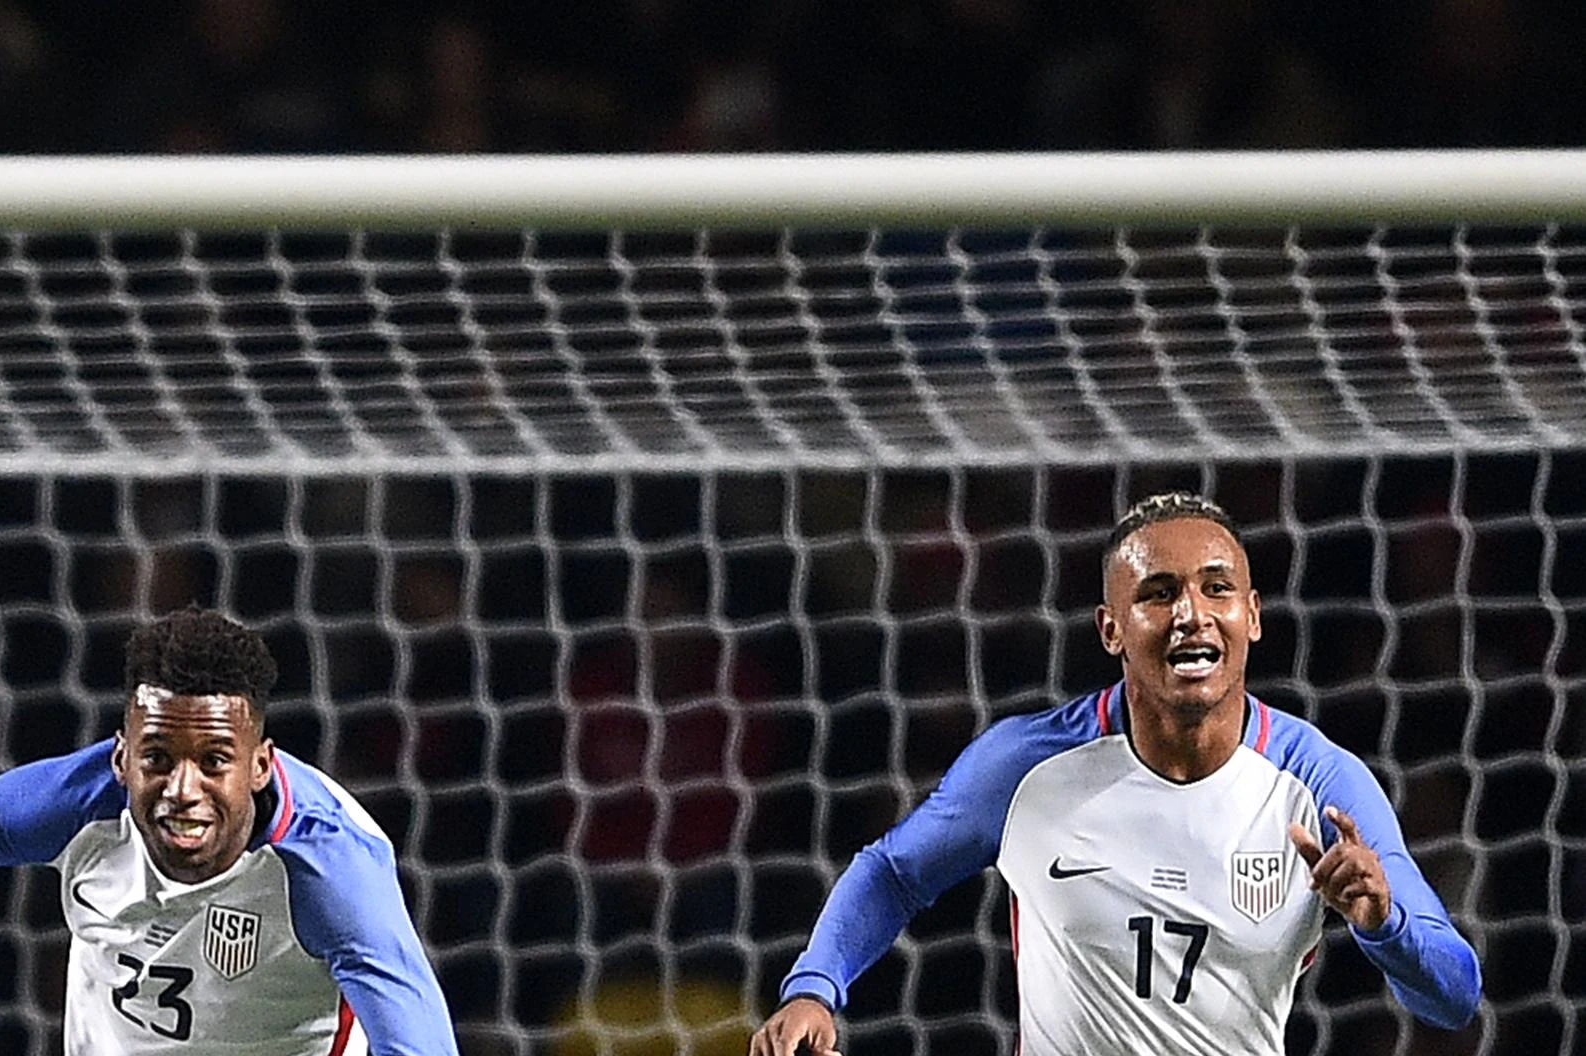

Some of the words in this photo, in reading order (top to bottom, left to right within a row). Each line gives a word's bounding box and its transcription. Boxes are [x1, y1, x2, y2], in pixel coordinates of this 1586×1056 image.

[1237, 857, 1280, 882] USA
[211, 909, 256, 941] USA
[1128, 916, 1209, 1004] 17
[112, 952, 194, 1042] 23
